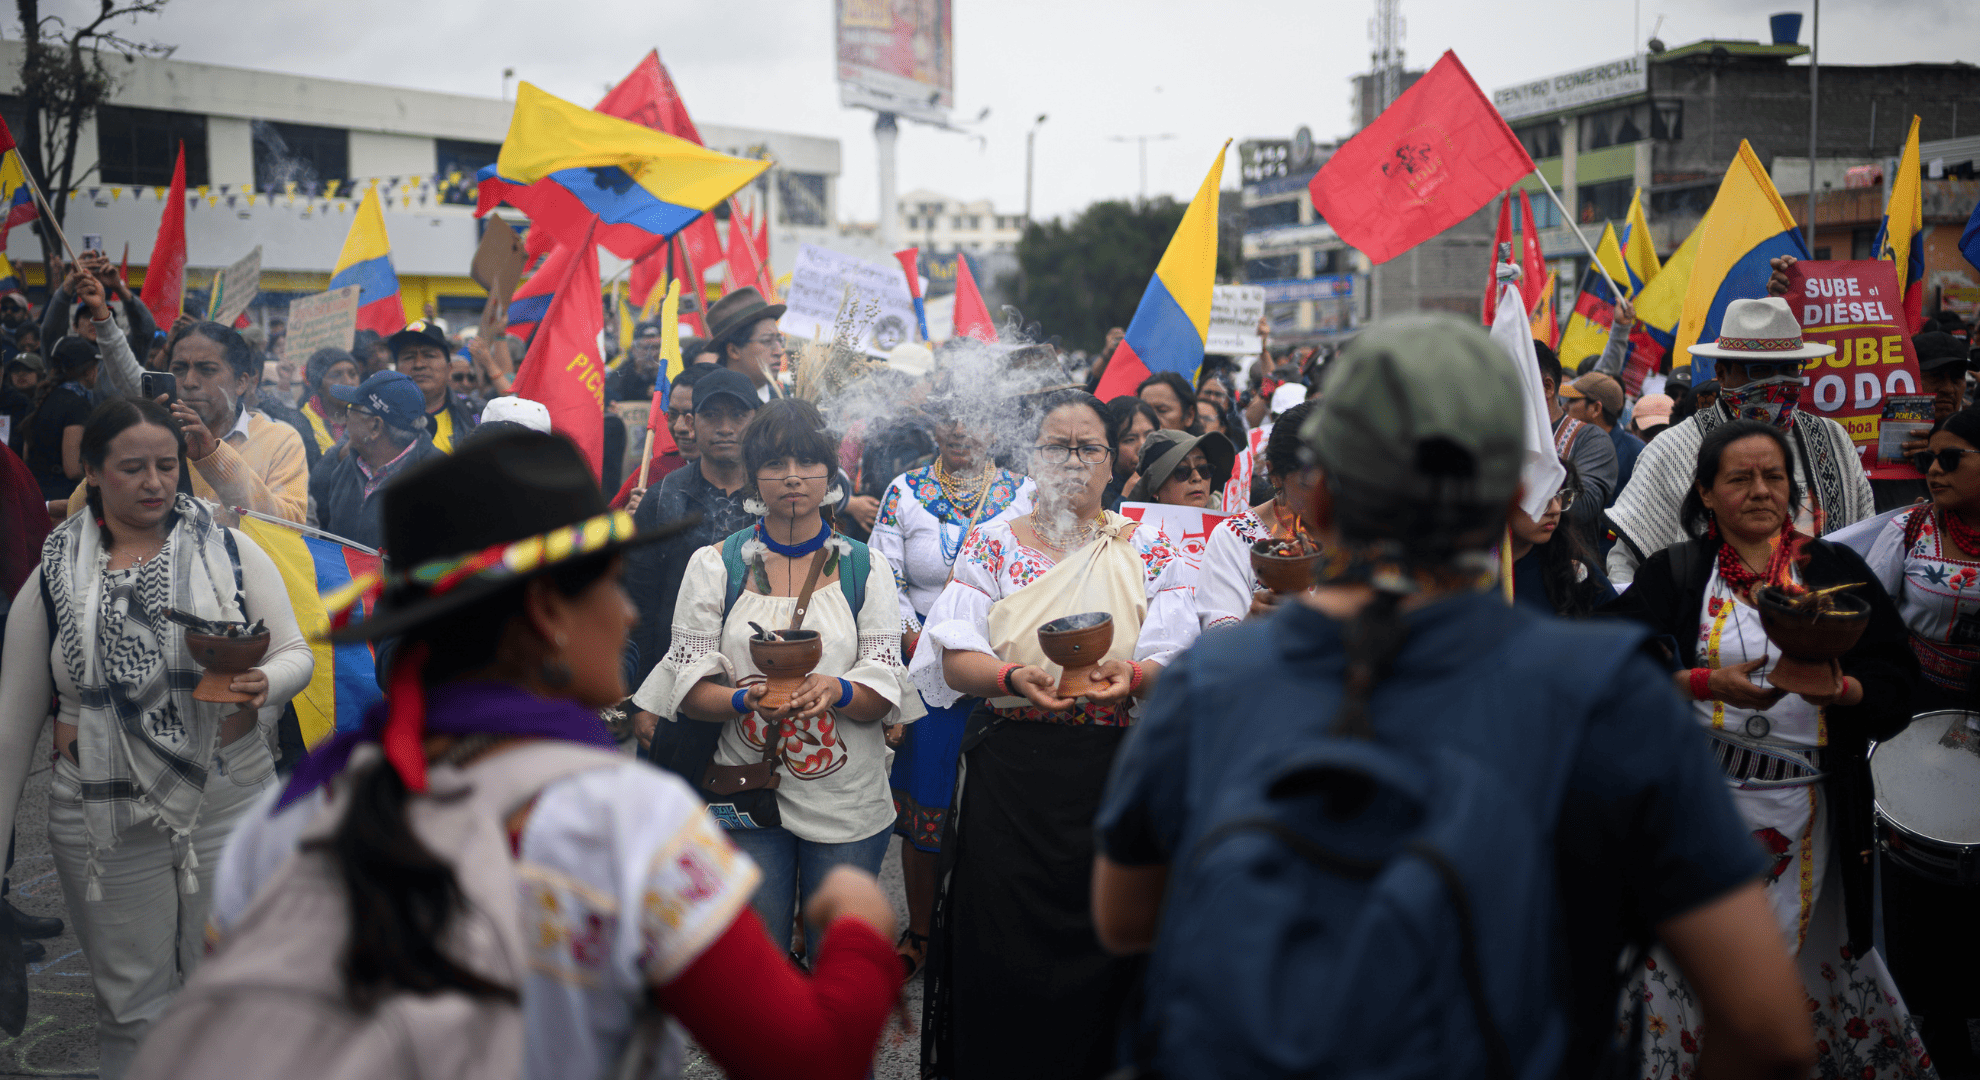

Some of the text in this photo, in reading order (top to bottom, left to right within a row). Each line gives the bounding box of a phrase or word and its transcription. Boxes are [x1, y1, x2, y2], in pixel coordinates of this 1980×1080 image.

[1494, 79, 1550, 104] CENTRO
[1554, 57, 1643, 92] COMERCIAL
[1805, 278, 1880, 298] SUBE el
[1803, 299, 1893, 325] DIÉSEL
[1803, 369, 1916, 412] ODO
